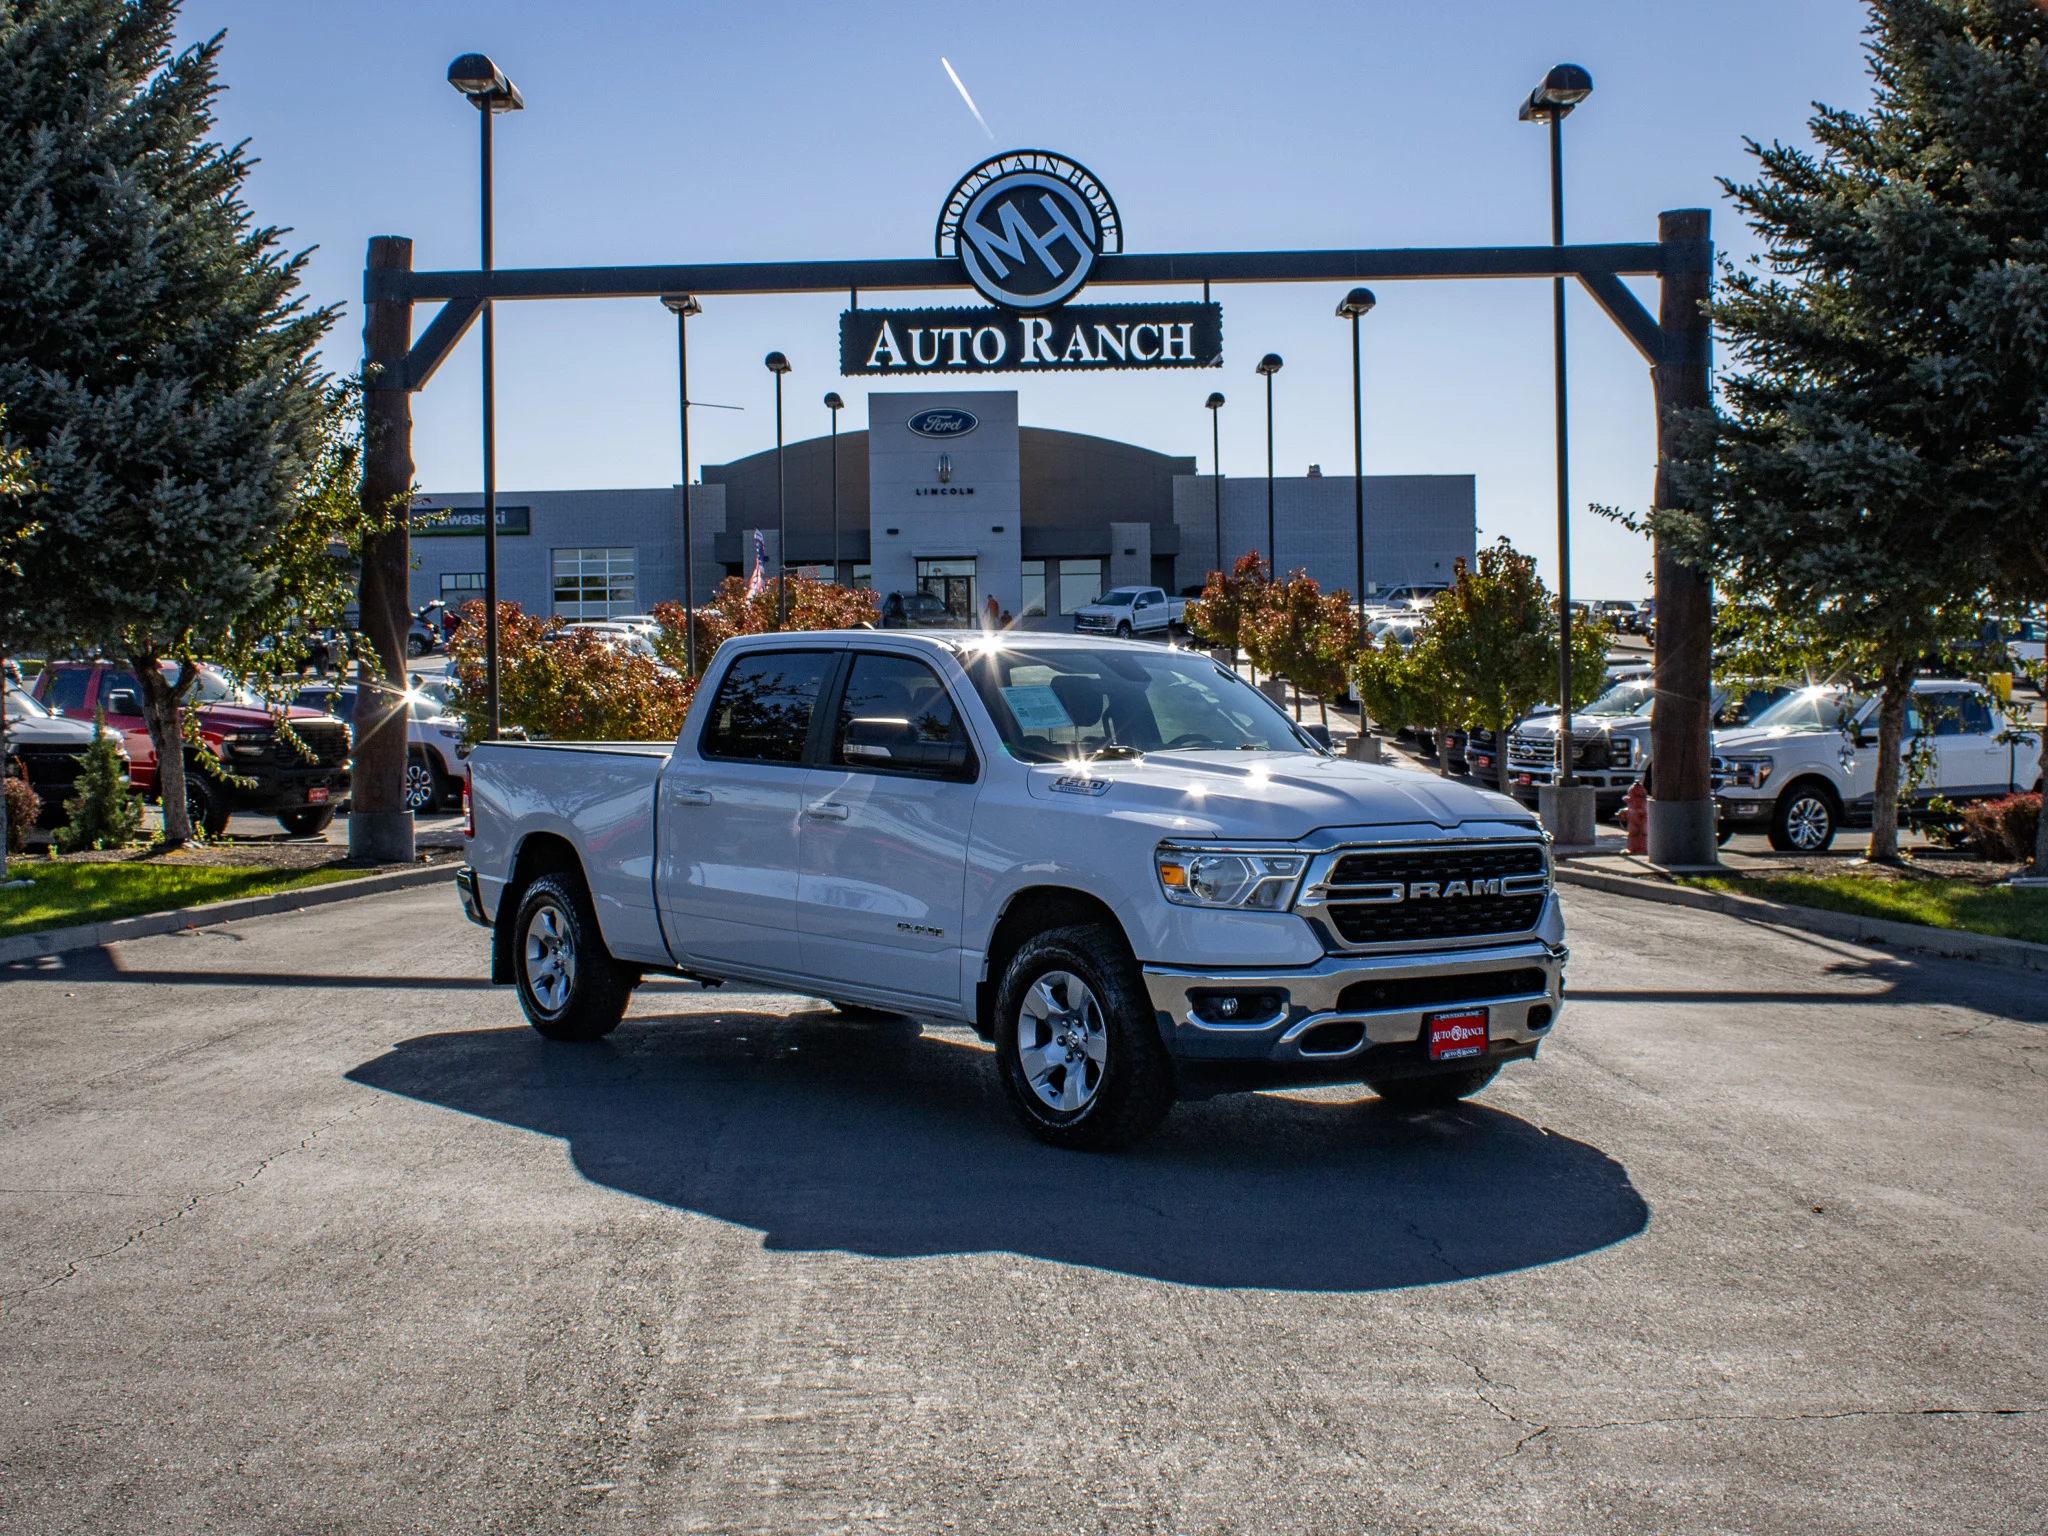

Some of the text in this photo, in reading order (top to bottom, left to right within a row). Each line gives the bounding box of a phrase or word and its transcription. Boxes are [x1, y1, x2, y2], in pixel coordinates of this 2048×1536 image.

[940, 154, 1118, 241] MOUNTAIN HOME
[866, 317, 1195, 367] AUTO RANCH
[923, 414, 962, 431] Ford
[916, 487, 974, 496] LINCOLN
[1410, 878, 1499, 899] RAM
[1432, 1031, 1450, 1042] AUTO
[1462, 1027, 1484, 1039] RANCH
